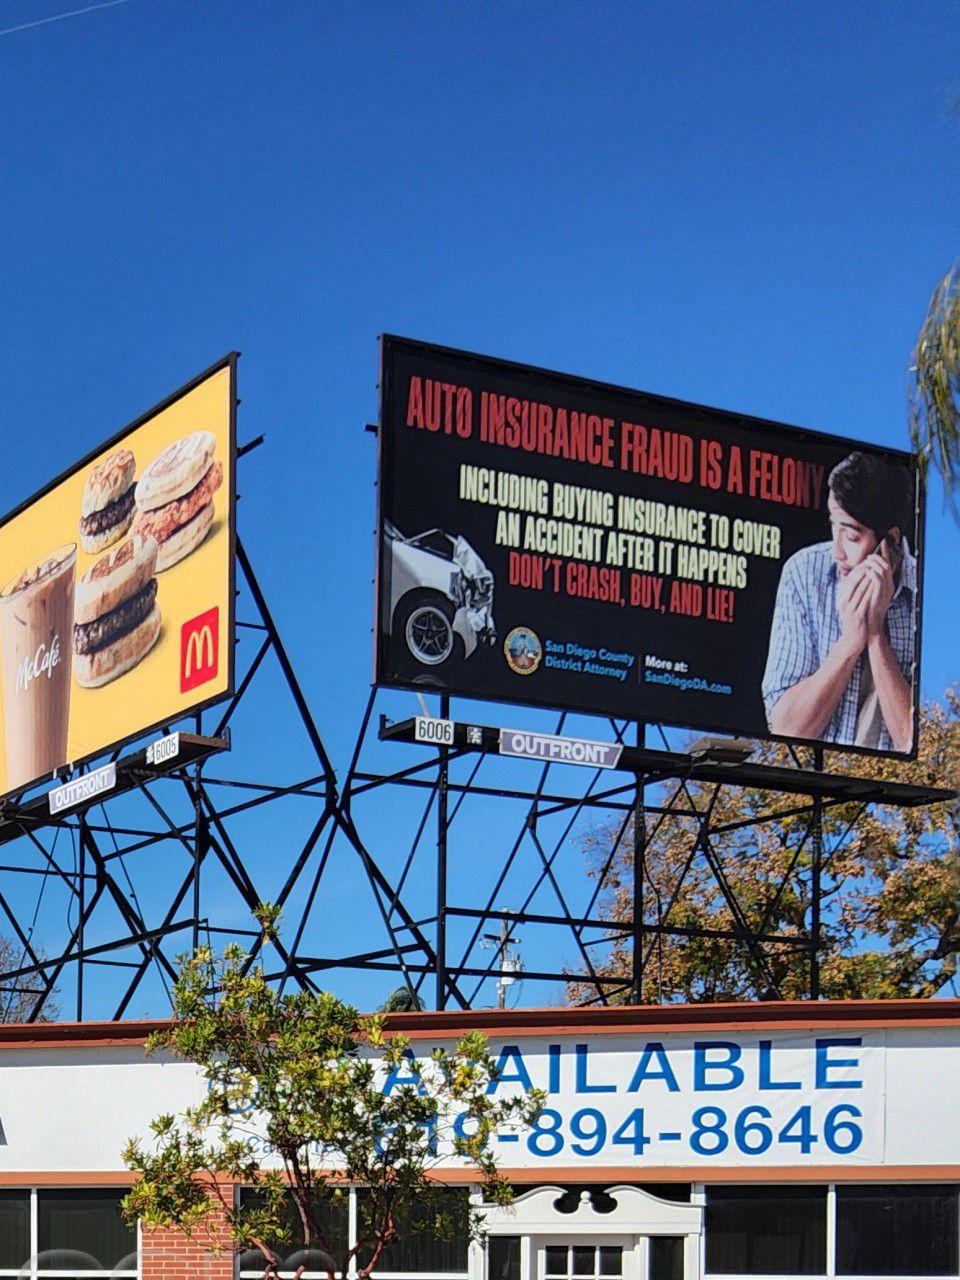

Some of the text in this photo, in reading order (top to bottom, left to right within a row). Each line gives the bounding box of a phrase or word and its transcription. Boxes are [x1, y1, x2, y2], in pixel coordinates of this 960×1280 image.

[407, 376, 825, 510] AUTO INSURANCE FRAUD IS A FELONY
[459, 464, 782, 559] INCLUDING BUYING INSURANCE TO COVER
[495, 510, 748, 589] AN ACCIDENT AFTER IT HAPPENS
[509, 552, 735, 623] DON'T CRASH, BUY, AND LIE!
[545, 639, 635, 667] San Diego County
[645, 655, 688, 673] More at:
[545, 655, 628, 681] District Attorney
[645, 671, 732, 695] SanDiegoDA.com
[418, 720, 451, 742] 6006
[156, 740, 177, 762] 6005
[511, 734, 610, 763] OUTFRONT
[55, 770, 111, 807] OUTFRONT
